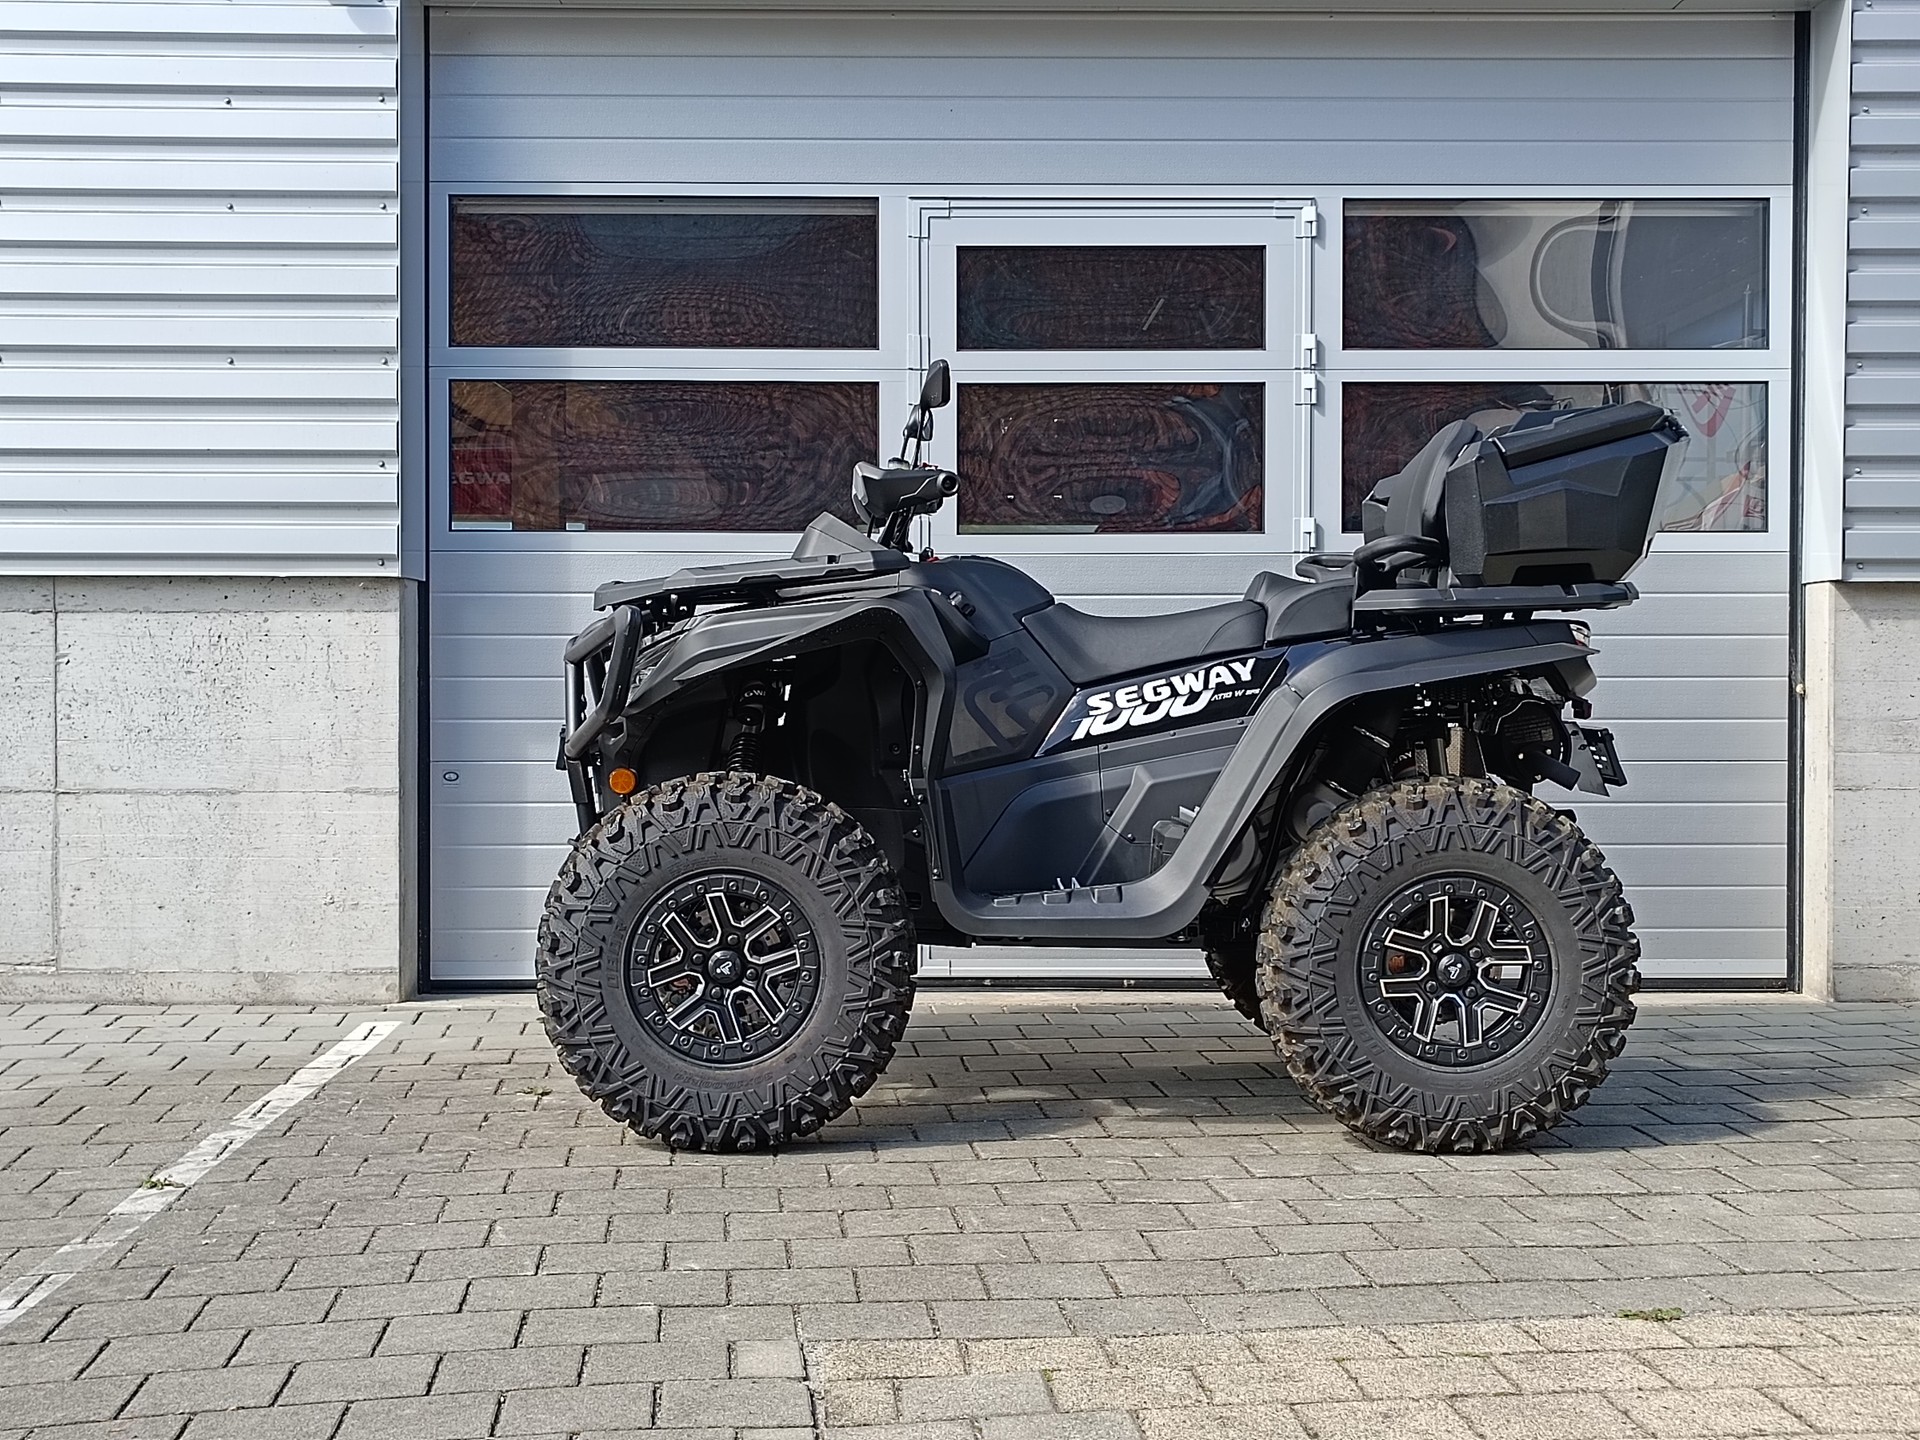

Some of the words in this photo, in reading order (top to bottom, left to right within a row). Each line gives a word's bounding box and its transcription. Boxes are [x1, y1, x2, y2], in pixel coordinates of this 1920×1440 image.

[1086, 657, 1256, 716] SEGWAY
[1234, 688, 1246, 698] W
[1070, 688, 1216, 741] 1000
